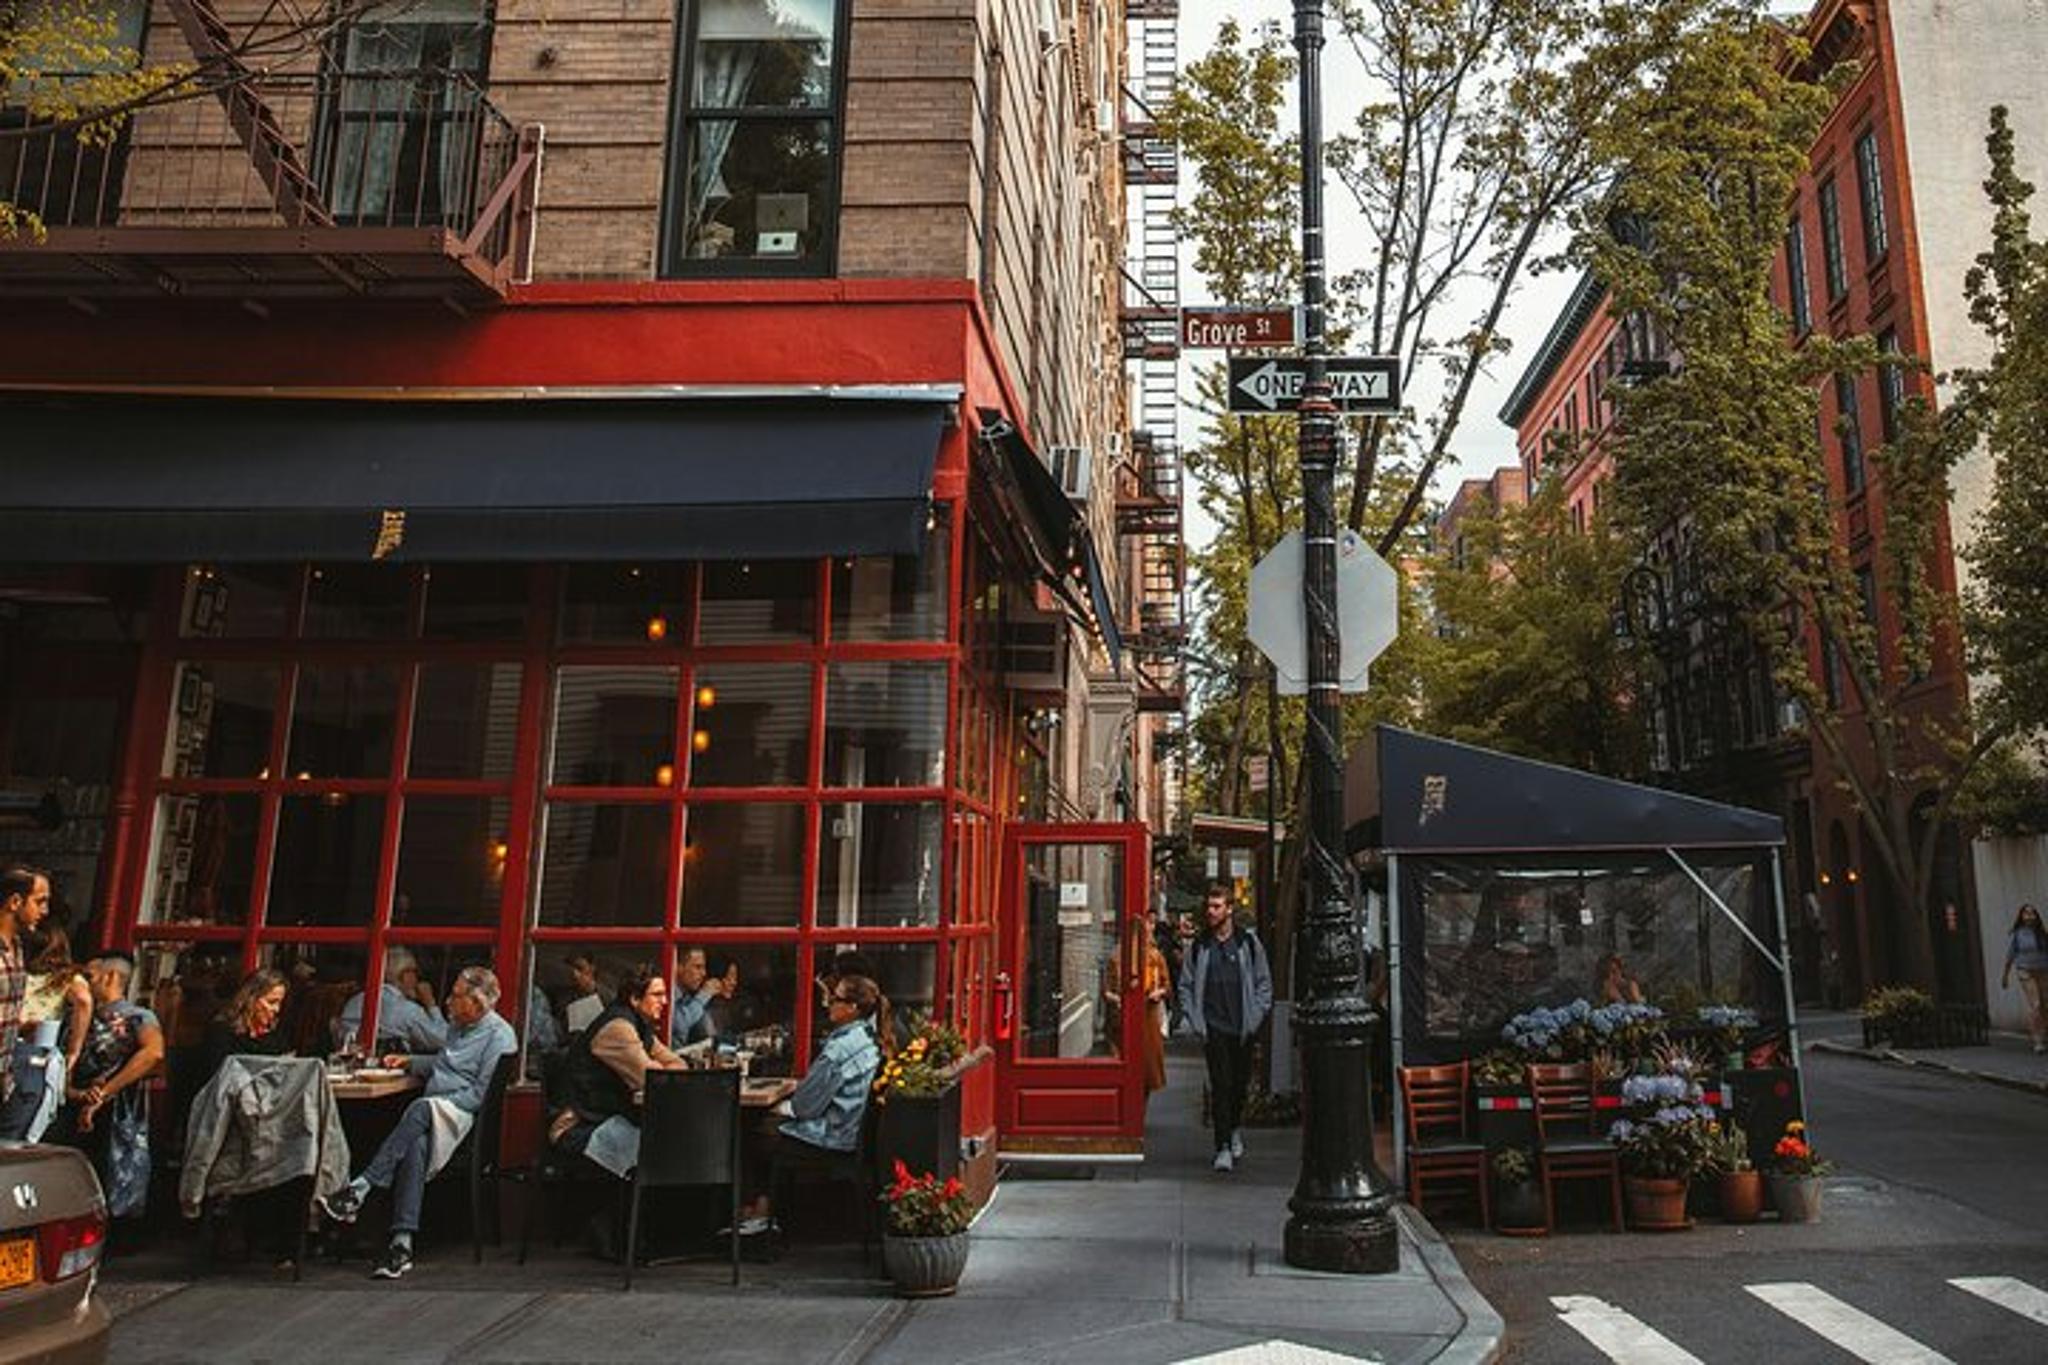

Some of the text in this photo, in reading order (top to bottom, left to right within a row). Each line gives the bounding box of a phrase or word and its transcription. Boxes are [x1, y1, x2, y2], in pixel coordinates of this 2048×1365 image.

[1188, 318, 1270, 345] Grove St
[1256, 374, 1379, 397] ONE WAY
